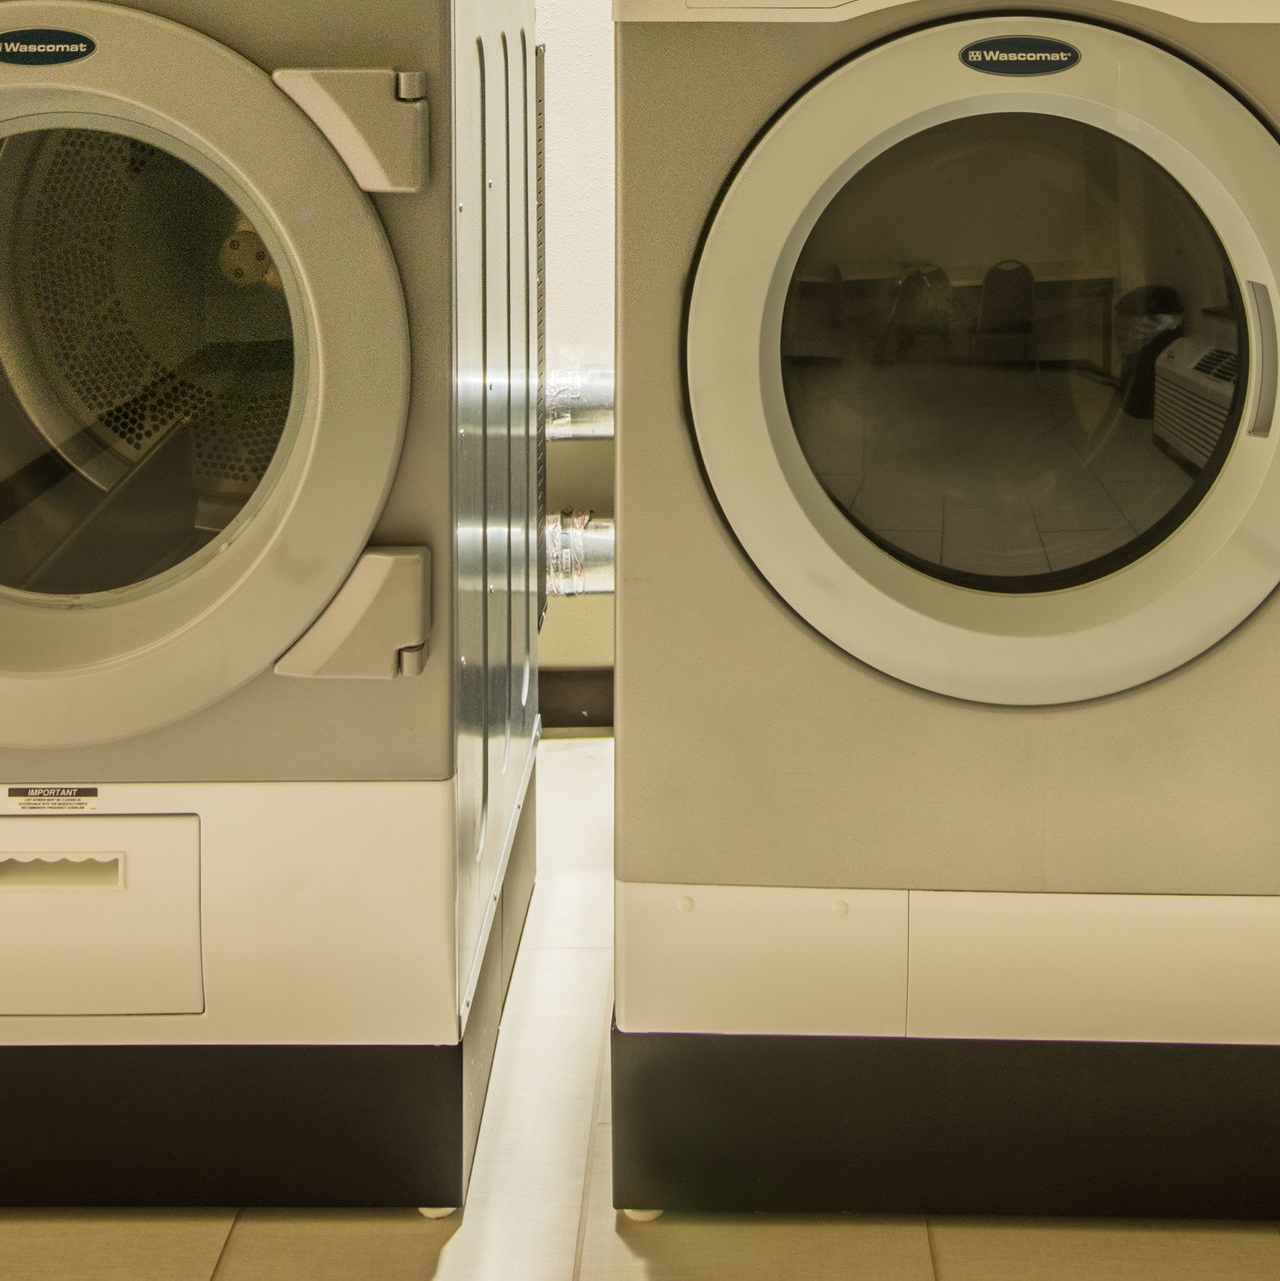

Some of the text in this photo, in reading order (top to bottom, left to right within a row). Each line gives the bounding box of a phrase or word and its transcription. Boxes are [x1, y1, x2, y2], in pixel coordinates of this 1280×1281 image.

[4, 42, 87, 52] Wascomat
[982, 50, 1068, 61] Wascomat
[27, 788, 78, 796] IMPORTANT
